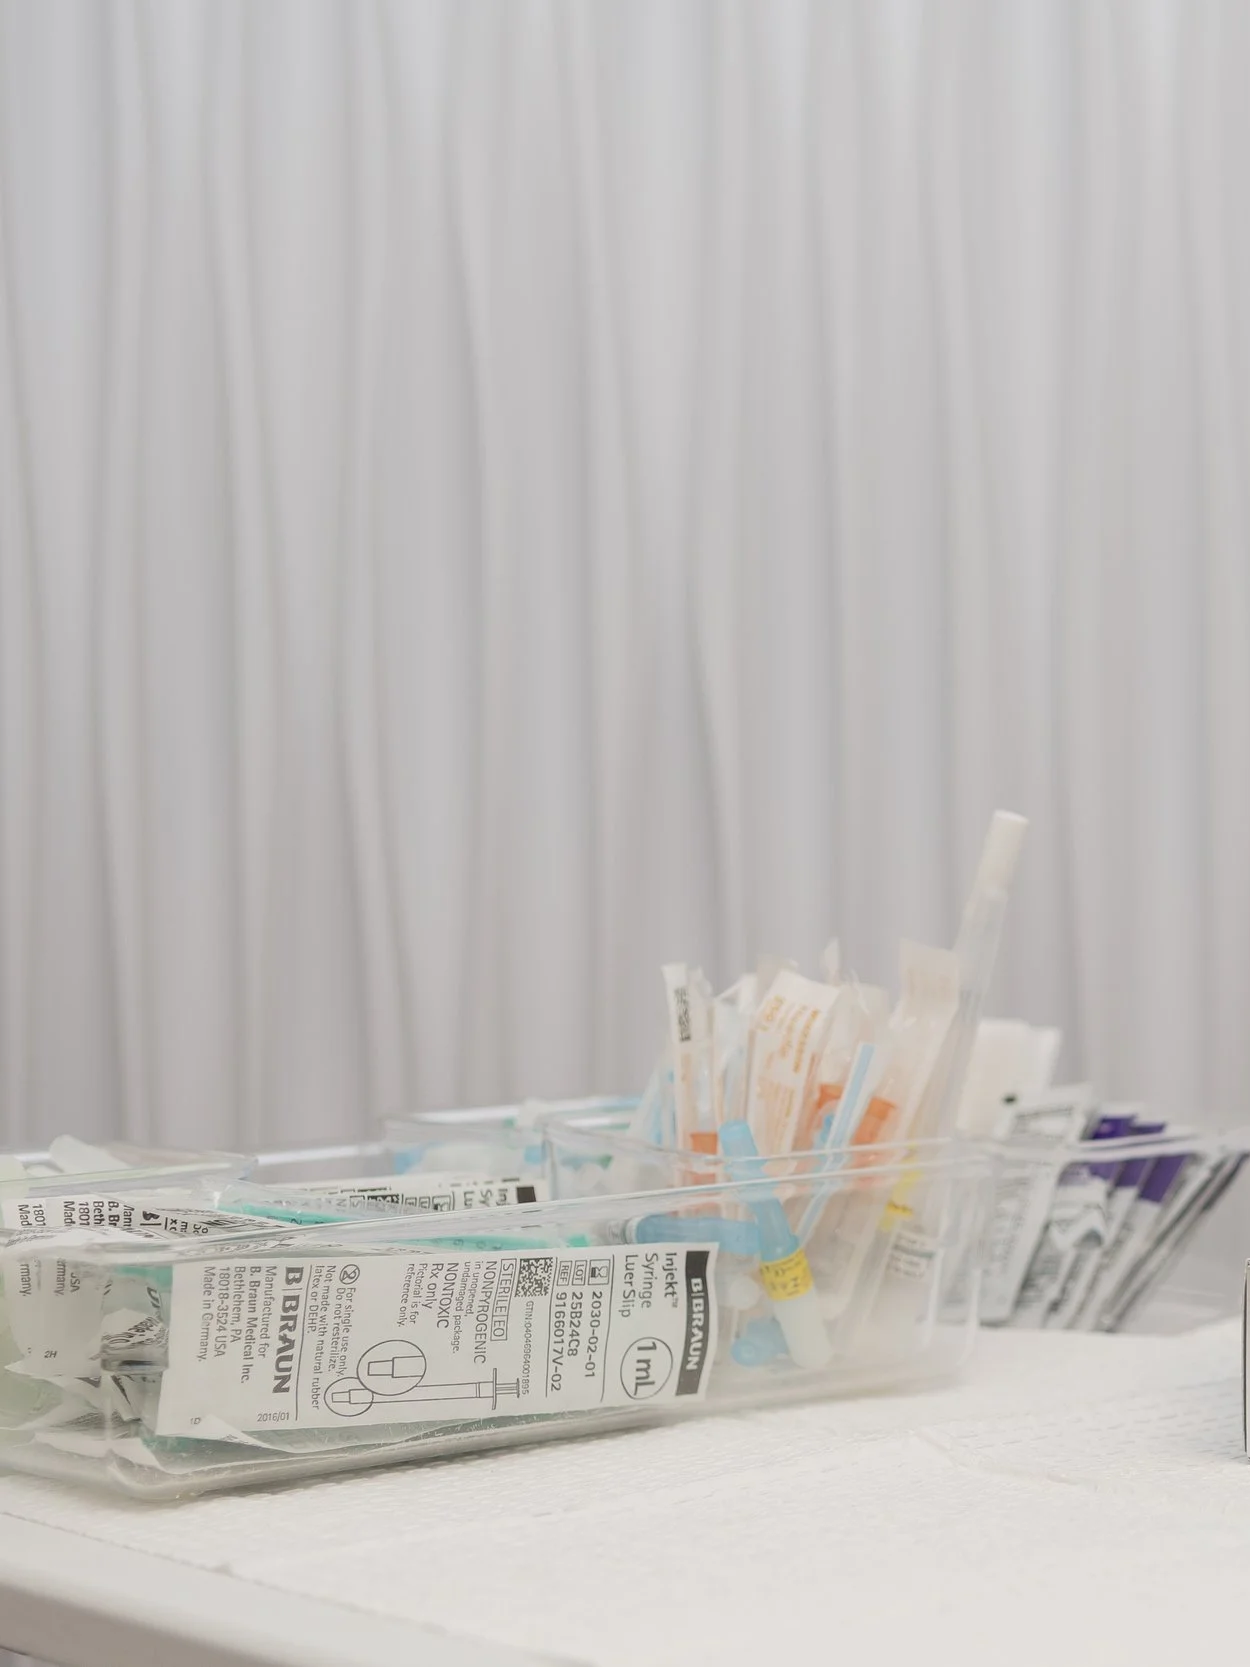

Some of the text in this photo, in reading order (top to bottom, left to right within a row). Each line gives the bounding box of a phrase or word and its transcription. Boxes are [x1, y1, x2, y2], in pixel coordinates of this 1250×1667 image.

[196, 1265, 216, 1363] Made Germany.
[213, 1266, 231, 1358] 18018-3524 USA
[229, 1265, 247, 1343] Bethlehem, PA
[258, 1265, 278, 1359] Manufactured for
[306, 1265, 325, 1334] latex or DEHP.
[396, 1263, 415, 1328] reference only.
[409, 1263, 428, 1325] Pictorial is for
[421, 1263, 444, 1310] Rx only
[436, 1262, 460, 1329] NONTOXIC
[451, 1261, 471, 1354] undamaged package.
[463, 1272, 480, 1318] unopened,
[473, 1260, 498, 1364] NONPYROGENIC
[492, 1263, 514, 1338] STERILE EO
[567, 1264, 584, 1357] LOT 25B24C8
[618, 1254, 639, 1318] Luer Slip
[638, 1252, 659, 1309] Syringe
[240, 1265, 262, 1384] B. Braun Medical Inc.
[311, 1265, 337, 1410] Not made with natural rubber
[328, 1287, 346, 1373] Do not resterilize.
[338, 1287, 356, 1378] For single use only.
[550, 1264, 570, 1392] REF 9166017V-02
[584, 1291, 603, 1378] 2030-02-01
[633, 1341, 658, 1397] 1 mL
[256, 1411, 290, 1423] 2016/01
